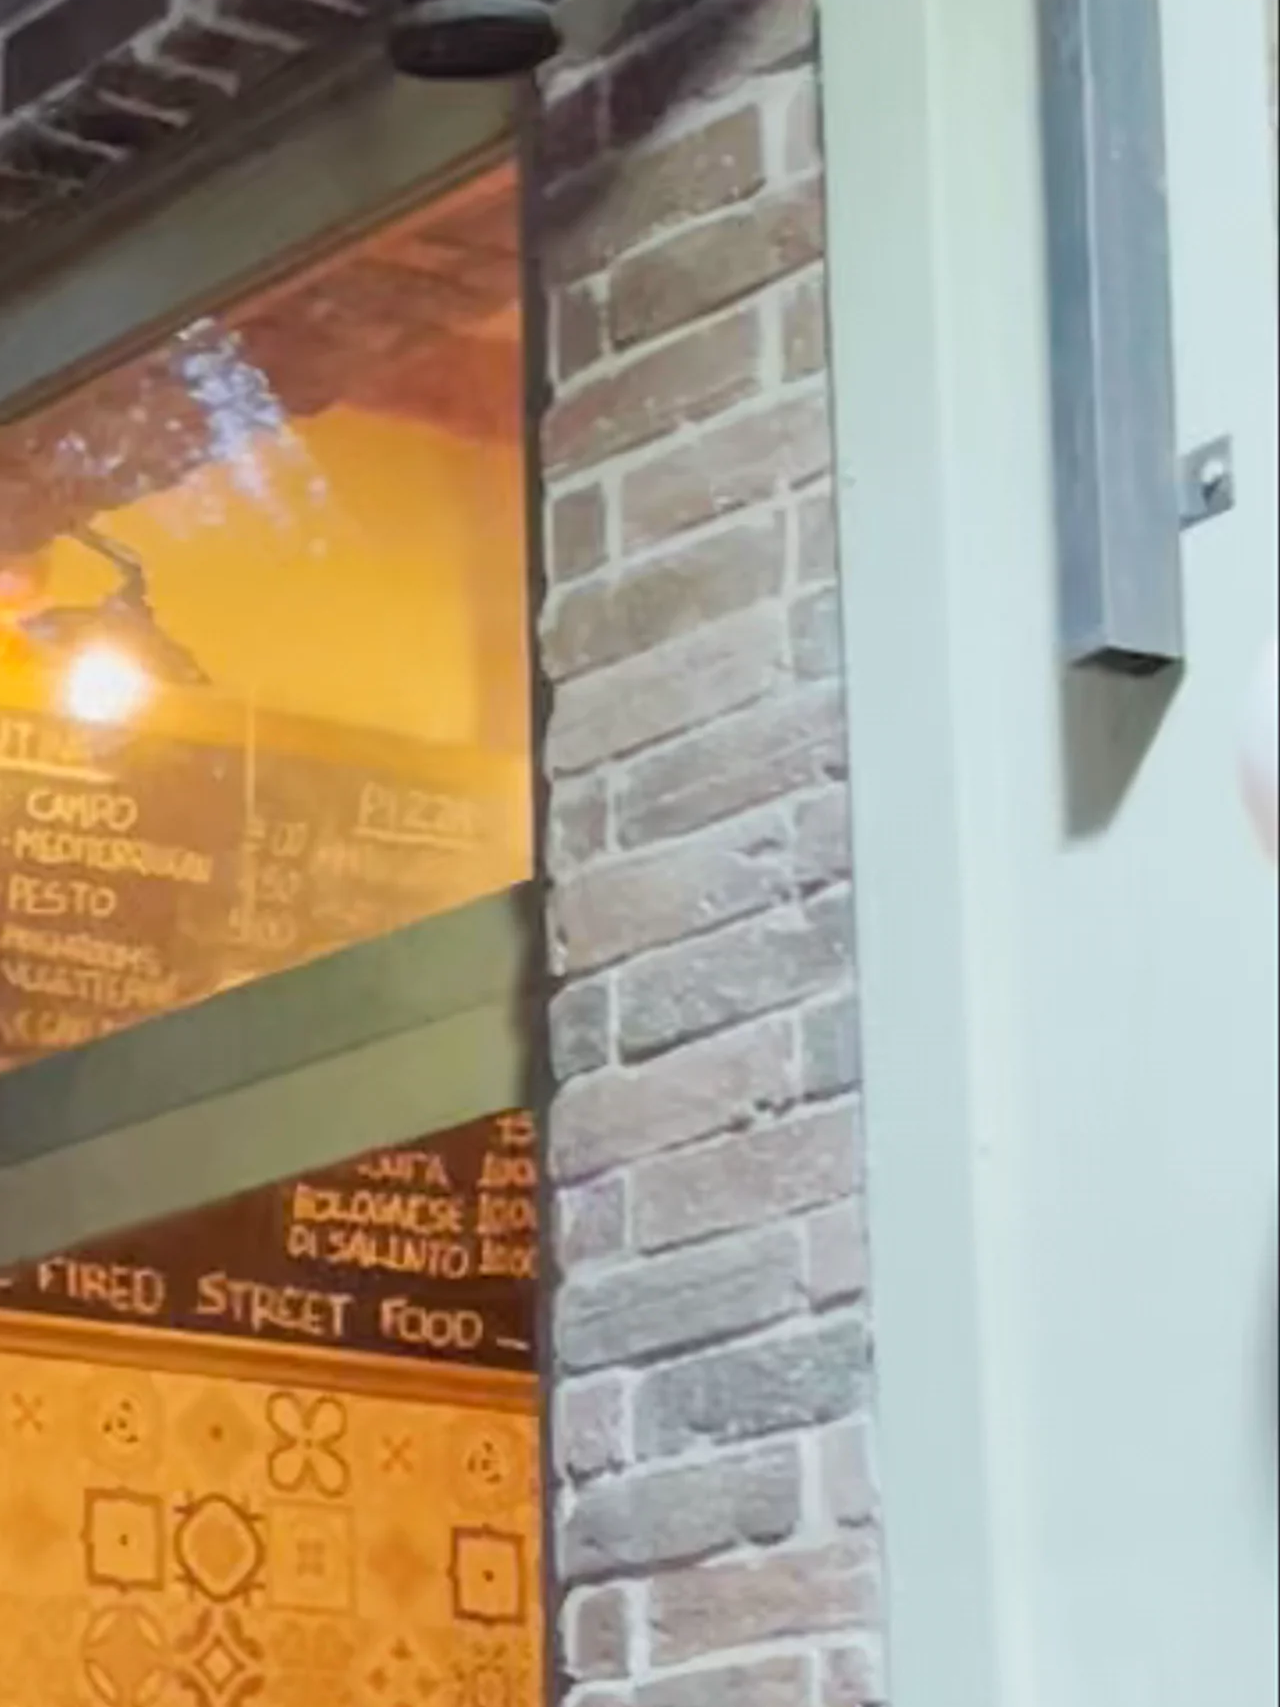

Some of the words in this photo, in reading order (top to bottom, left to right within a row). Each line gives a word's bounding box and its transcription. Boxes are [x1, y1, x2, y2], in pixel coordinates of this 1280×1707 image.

[8, 872, 119, 919] PESTO
[38, 1257, 166, 1316] FIRED
[197, 1270, 353, 1337] STREET
[380, 1297, 484, 1348] FOOD
